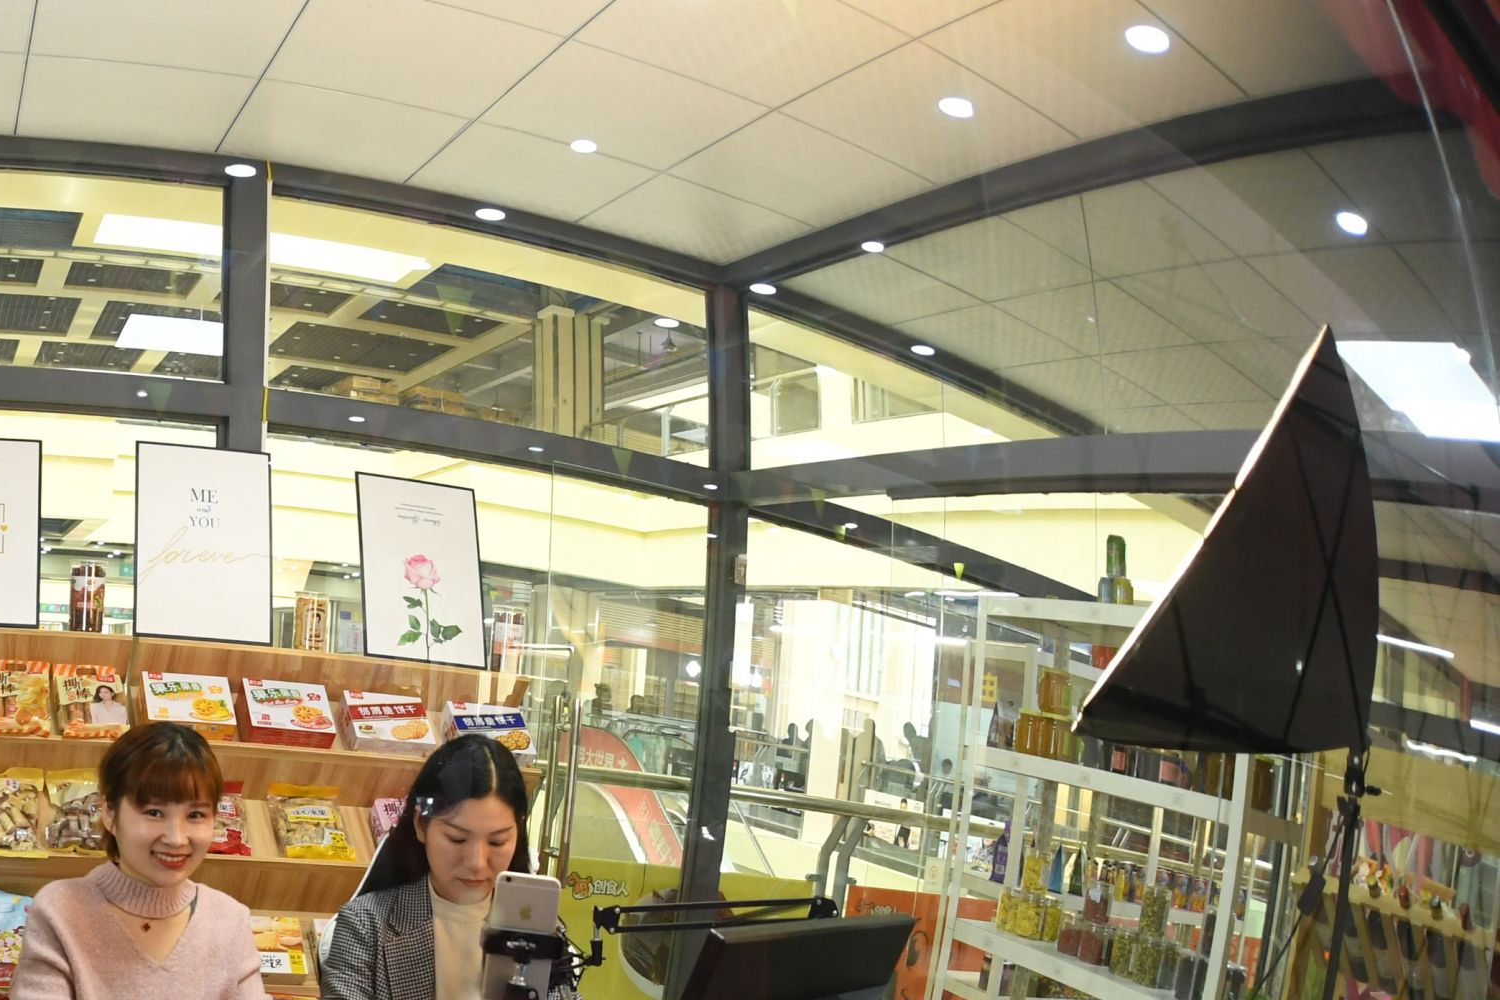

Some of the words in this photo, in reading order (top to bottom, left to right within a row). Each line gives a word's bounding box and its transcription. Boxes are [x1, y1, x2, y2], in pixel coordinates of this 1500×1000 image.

[190, 488, 219, 504] ME
[190, 516, 220, 529] YOU
[138, 525, 270, 586] forever
[357, 704, 418, 718] 甜薄脆饼干
[462, 715, 517, 728] 甜薄脆饼干
[593, 879, 629, 897] 创食人
